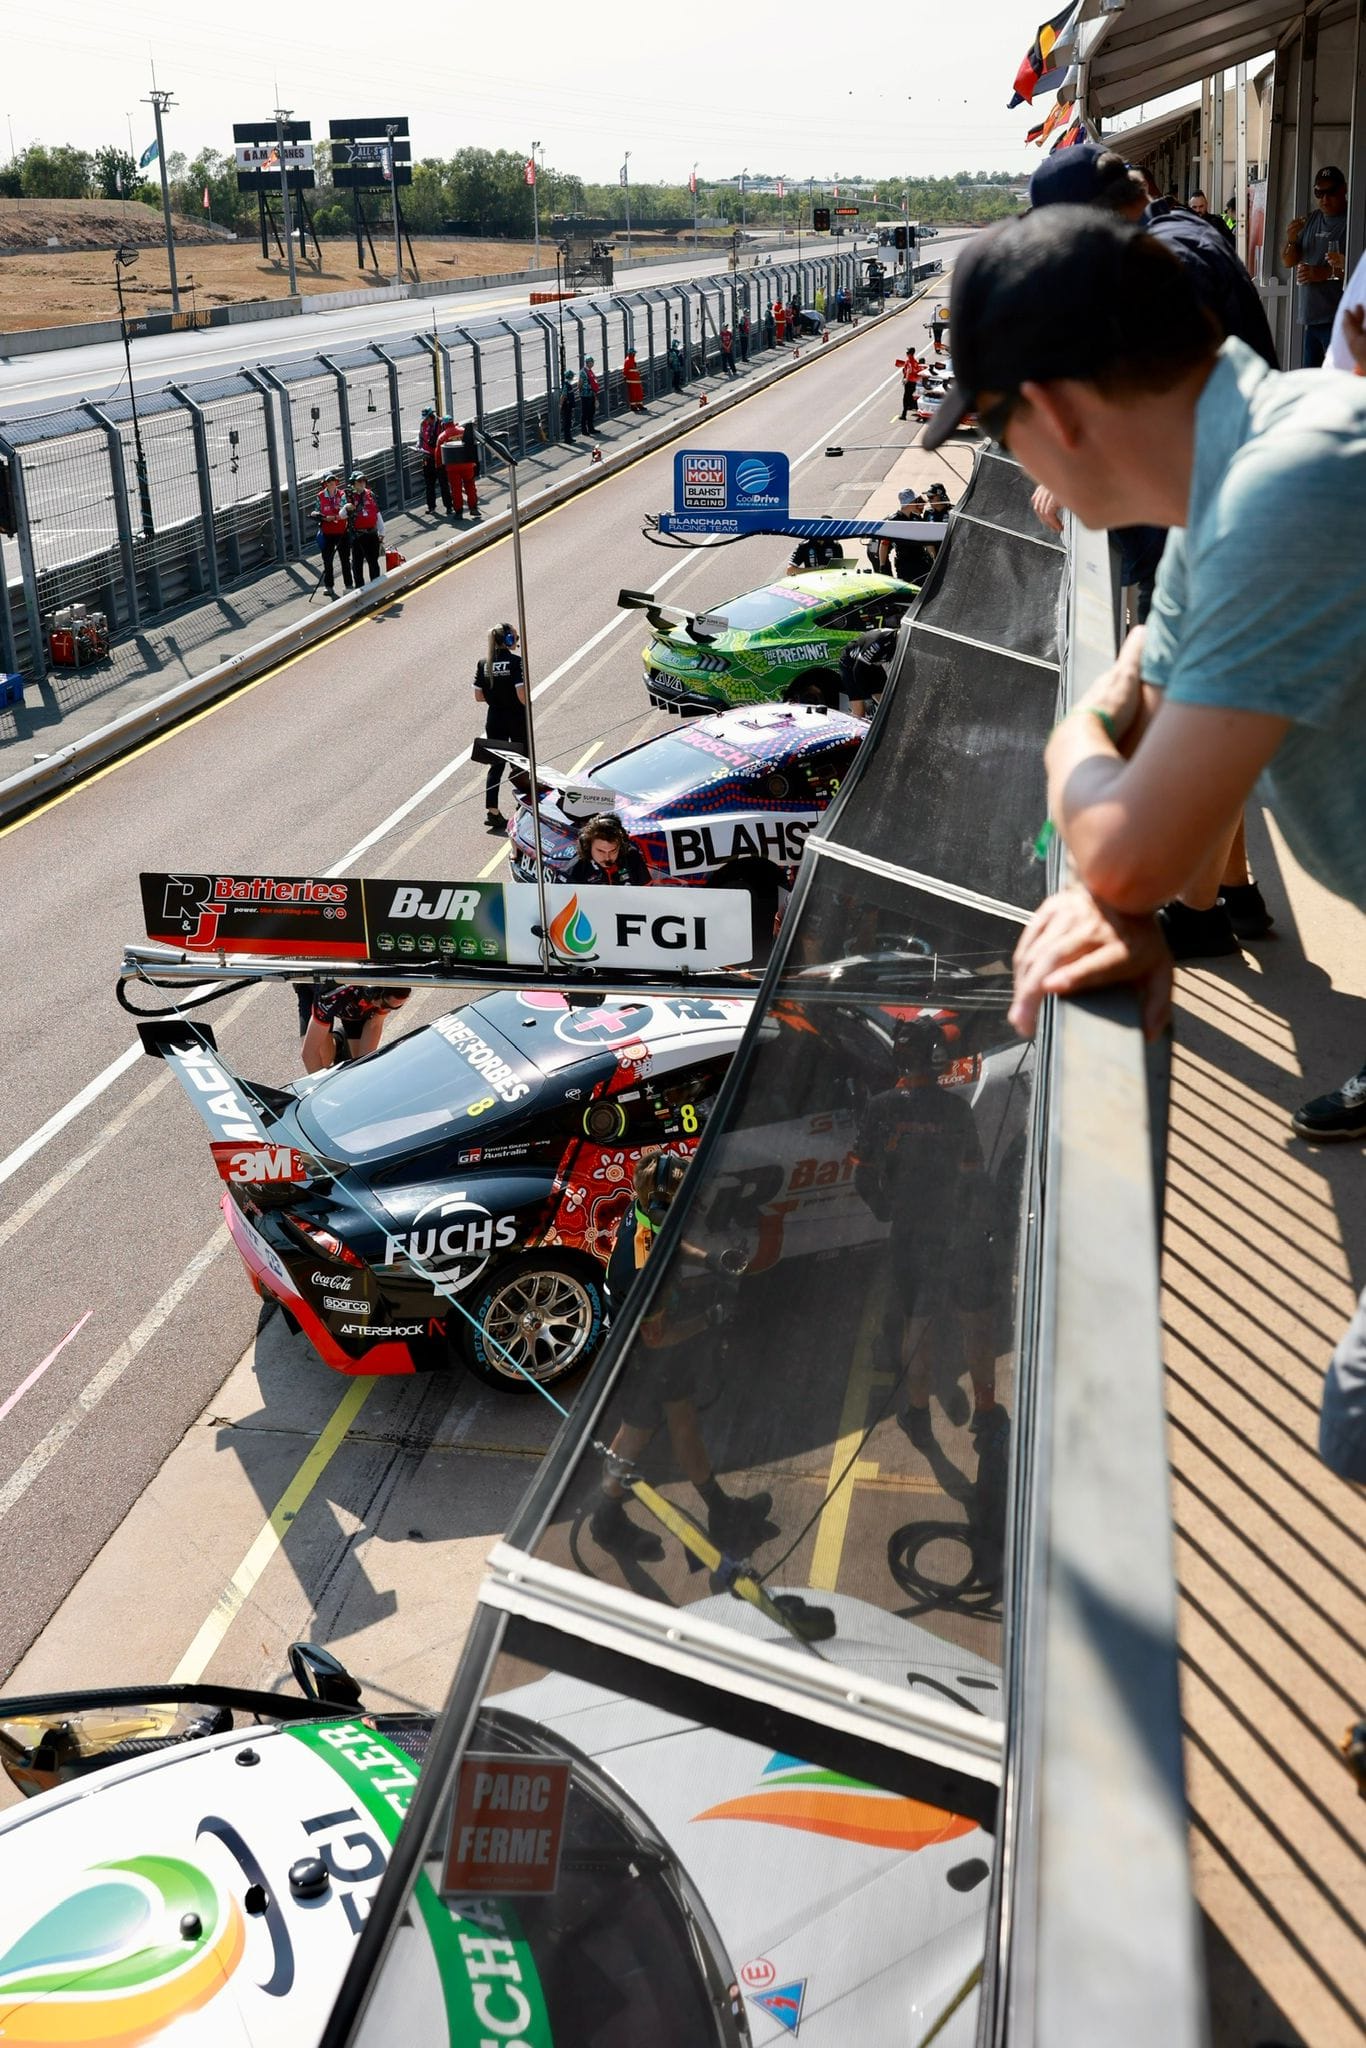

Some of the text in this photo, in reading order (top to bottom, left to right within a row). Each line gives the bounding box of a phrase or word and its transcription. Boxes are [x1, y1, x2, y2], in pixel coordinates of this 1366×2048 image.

[688, 459, 722, 471] LIQUI
[688, 472, 722, 482] MOLY
[688, 488, 721, 496] BLAHST
[736, 494, 779, 504] CoolDrive
[668, 518, 738, 526] BLANCHARD
[875, 615, 884, 629] 7
[763, 642, 829, 664] THE PRECINCT
[681, 731, 751, 766] BOSCH
[829, 778, 841, 797] 3
[214, 877, 348, 902] Batteries
[388, 888, 481, 921] BJR
[615, 914, 707, 950] FGI
[467, 1097, 495, 1117] 8
[680, 1104, 698, 1133] 8
[460, 1153, 481, 1163] GR
[484, 1148, 527, 1159] Australia
[229, 1149, 292, 1182] 3M
[385, 1215, 517, 1265] FUCHS
[325, 1298, 368, 1312] sparco
[340, 1324, 424, 1336] AFTERSHOCK
[472, 1772, 550, 1812] PARC
[457, 1825, 552, 1865] FERME
